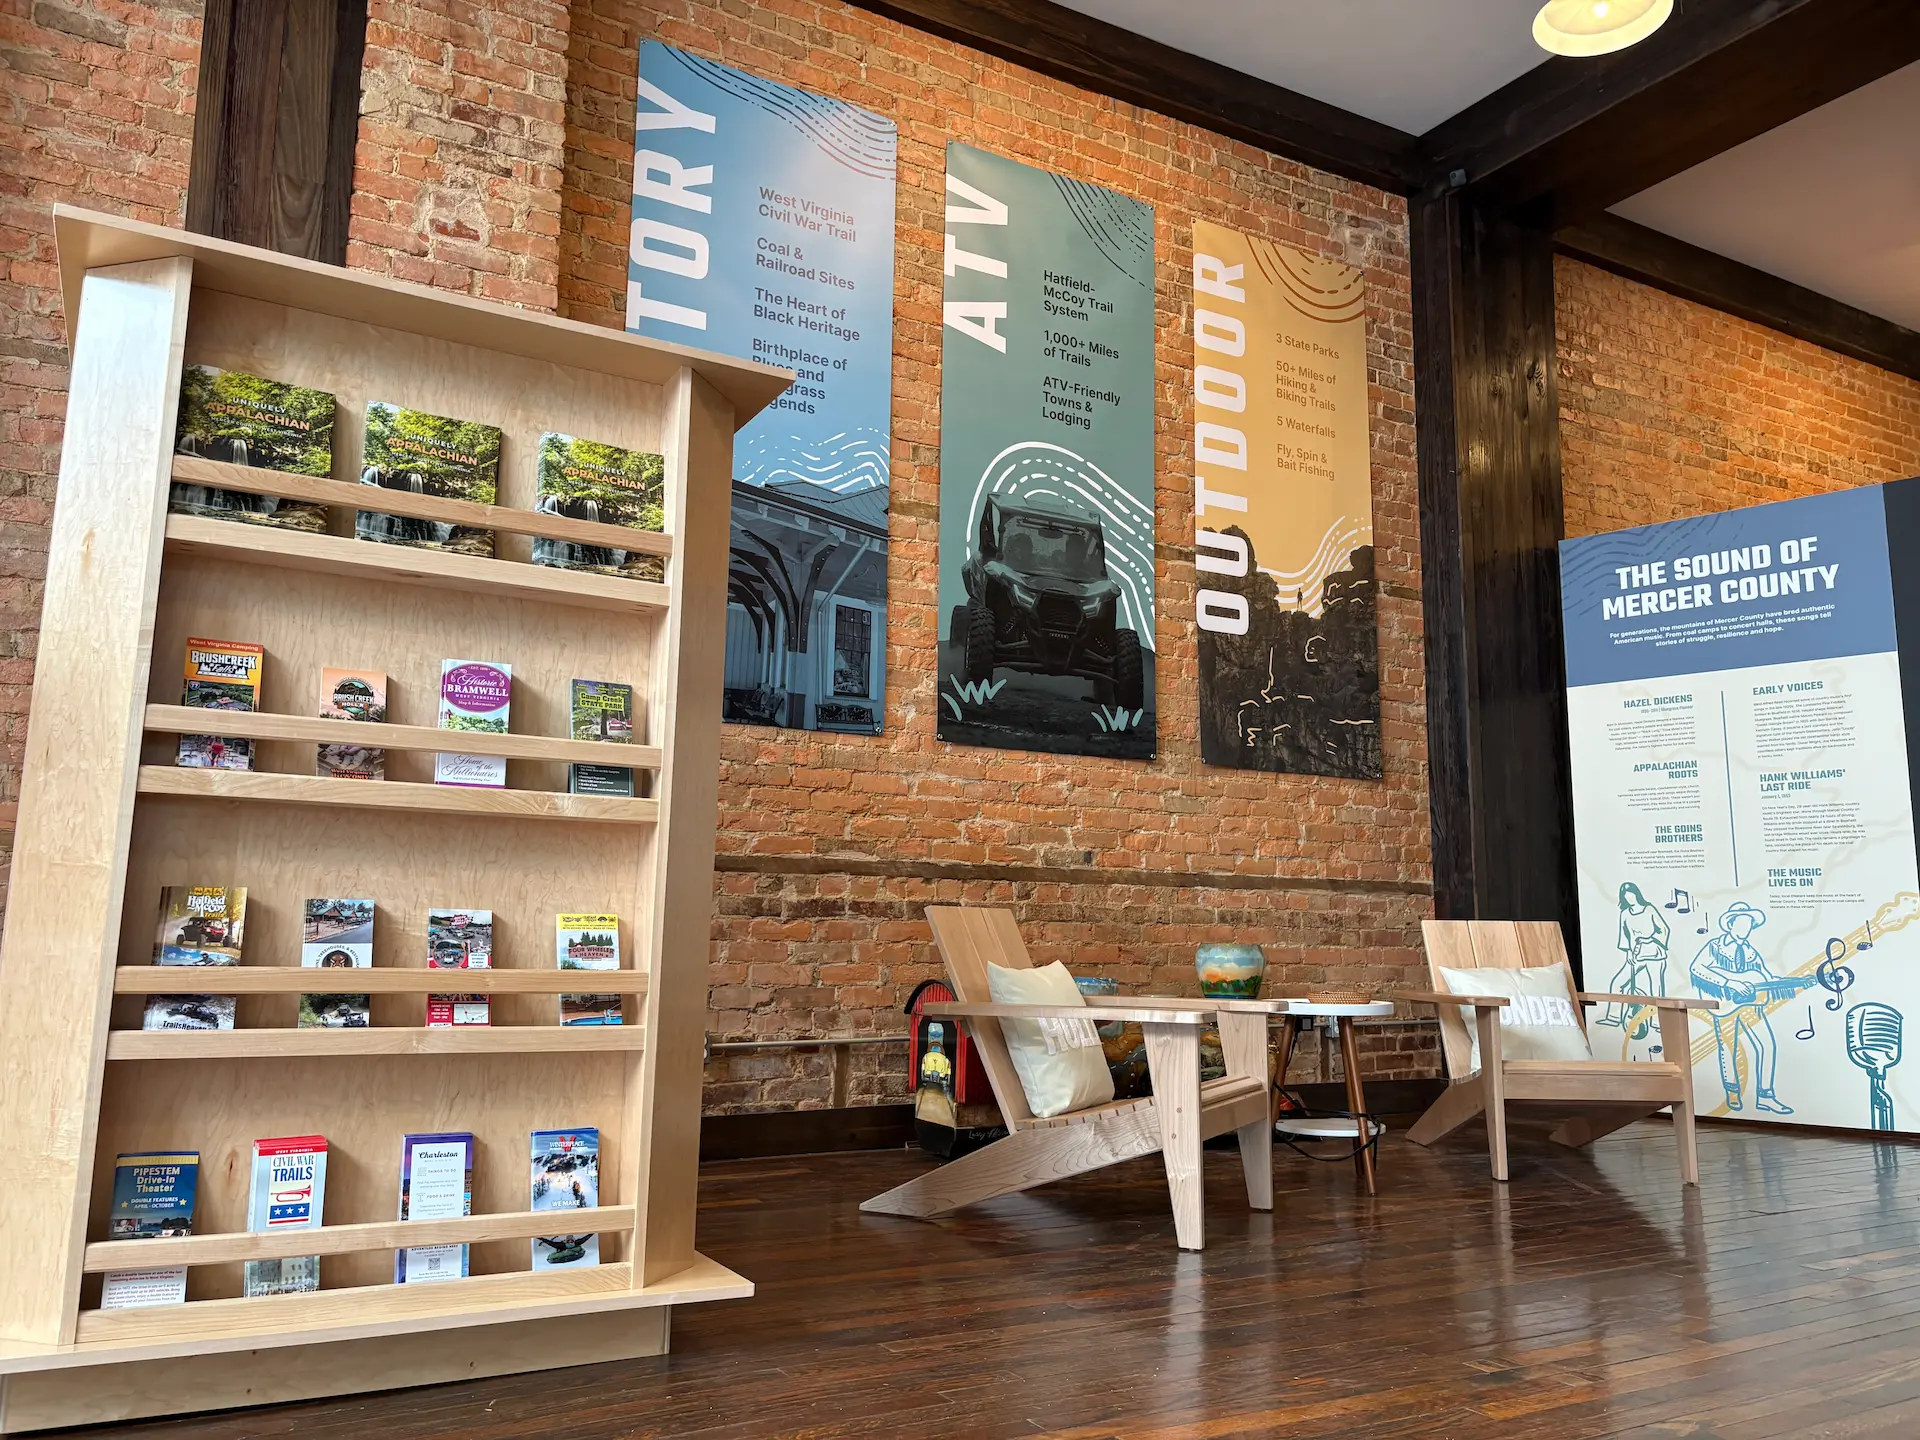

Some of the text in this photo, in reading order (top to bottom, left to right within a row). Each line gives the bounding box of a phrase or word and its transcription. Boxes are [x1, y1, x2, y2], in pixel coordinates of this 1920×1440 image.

[759, 186, 854, 226] West Virginia
[758, 203, 856, 242] Civil War Trail
[756, 237, 804, 261] Coal &
[756, 253, 855, 290] Railroad Sites
[942, 172, 1008, 354] ATV
[1043, 269, 1096, 294] Hatfield-
[754, 287, 846, 320] The Heart of
[1043, 284, 1114, 314] McCoy Trail
[1043, 300, 1089, 322] System
[753, 304, 860, 342] Black Heritage
[752, 338, 829, 367] Birthplace
[832, 358, 847, 371] of
[1044, 329, 1119, 360] 1,000+ Miles
[1275, 333, 1340, 360] 3 State Parks
[1043, 346, 1092, 368] of Trails
[797, 368, 825, 383] and
[1276, 360, 1337, 386] 50+ Miles of
[1043, 375, 1121, 406] ATV-Friendly
[1276, 374, 1317, 394] Hiking &
[232, 397, 287, 414] UNIQUELY
[1043, 390, 1093, 413] Towns &
[1276, 388, 1336, 412] Biking Trails
[205, 402, 310, 431] APPALACHIAN
[1042, 406, 1091, 430] Lodging
[1276, 415, 1336, 439] 5 Waterfalls
[387, 437, 478, 466] APPALACHIAN
[410, 433, 457, 450] UNIQUELY
[1193, 252, 1249, 636] OUTDOOR
[1276, 443, 1328, 464] Fly, Spin &
[563, 467, 646, 491] APPALACHIAN
[584, 462, 626, 476] UNIQUELY
[1277, 457, 1335, 481] Bait Fishing
[1615, 536, 1818, 590] THE SOUND OF
[1602, 563, 1839, 621] MERCER COUNTY
[1614, 636, 1643, 645] American
[1644, 633, 1665, 642] music.
[1698, 625, 1720, 635] camps
[1729, 621, 1755, 631] concert
[1775, 616, 1796, 624] these
[1797, 613, 1819, 622] songs
[1621, 628, 1659, 639] generations,
[1671, 620, 1705, 630] mountains
[1715, 616, 1738, 624] Mercer
[1740, 613, 1764, 622] County
[1765, 610, 1782, 618] have
[1783, 608, 1800, 616] bred
[1801, 603, 1835, 614] authentic
[207, 640, 231, 648] Virginia
[231, 643, 259, 652] Camping
[1656, 639, 1677, 647] stories
[1686, 634, 1716, 644] struggle,
[1716, 630, 1749, 639] resilience
[1750, 627, 1763, 635] and
[1764, 625, 1784, 634] hope.
[191, 650, 257, 669] BRUSHCREEK
[211, 664, 235, 674] Falls
[447, 683, 509, 697] BRAMWELL
[457, 673, 498, 687] Historic
[1752, 680, 1823, 696] EARLY VOICES
[333, 693, 375, 704] BRUSH CREEK
[581, 693, 601, 702] Camp
[581, 699, 623, 710] STATE PARK
[1623, 694, 1693, 709] HAZEL DICKENS
[453, 754, 483, 765] Home
[1633, 760, 1697, 772] APPALACHIAN
[441, 763, 498, 778] Millionaires
[1668, 769, 1698, 779] ROOTS
[1760, 768, 1846, 783] HANK WILLIAMS'
[1760, 780, 1811, 792] LAST RIDE
[1654, 824, 1702, 834] THE GOINS
[1655, 833, 1703, 843] BROTHERS
[1767, 867, 1822, 877] THE MUSIC
[1768, 878, 1814, 887] LIVES ON
[568, 946, 615, 955] FOUR WHEELER
[273, 1154, 314, 1168] CIVIL WAR
[418, 1150, 459, 1160] Charleston
[133, 1166, 180, 1177] PIPESTEM
[136, 1176, 175, 1185] Drive-In
[273, 1166, 313, 1182] TRAILS
[136, 1184, 175, 1193] Theater
